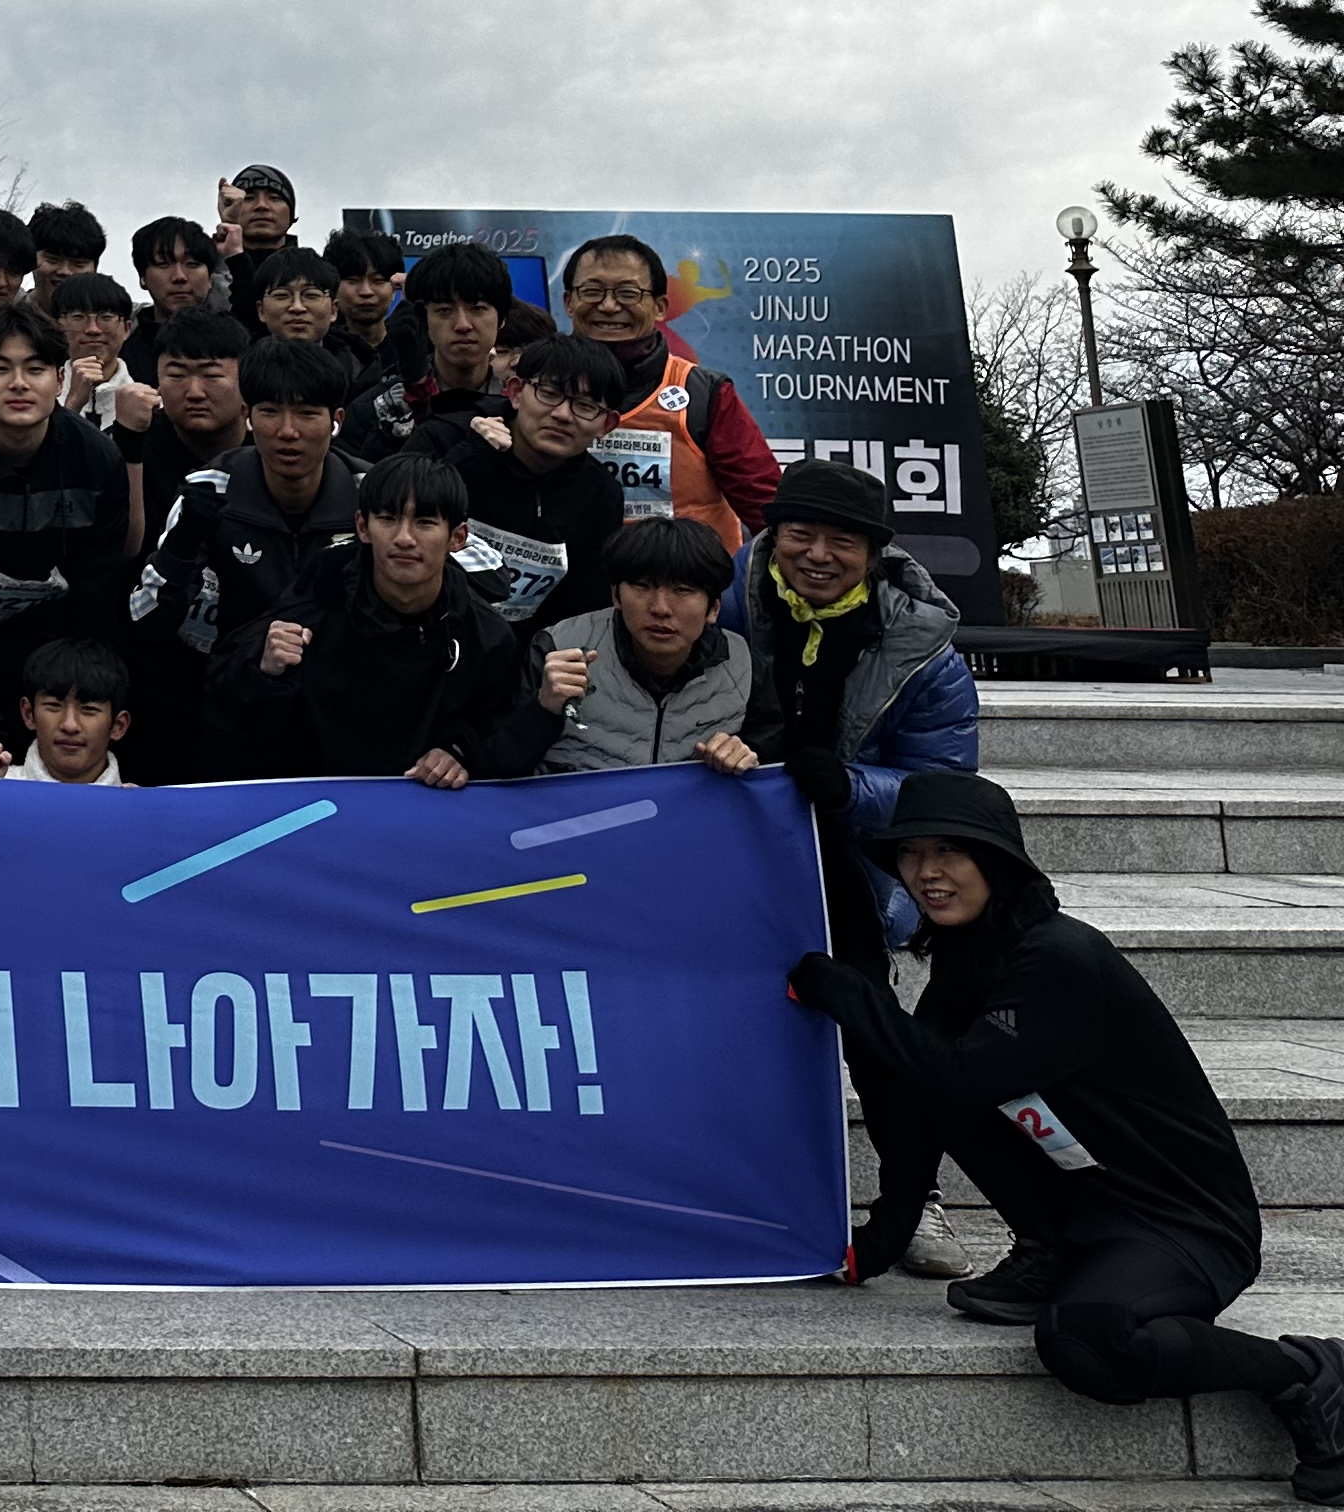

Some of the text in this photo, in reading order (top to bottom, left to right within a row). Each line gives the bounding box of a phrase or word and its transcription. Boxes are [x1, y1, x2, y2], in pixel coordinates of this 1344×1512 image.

[405, 230, 474, 250] Together
[743, 257, 822, 283] 2025
[750, 296, 830, 322] JINJU
[753, 334, 912, 364] MARATHON
[756, 373, 950, 405] TOURNAMENT
[61, 970, 606, 1115] 나아가자!
